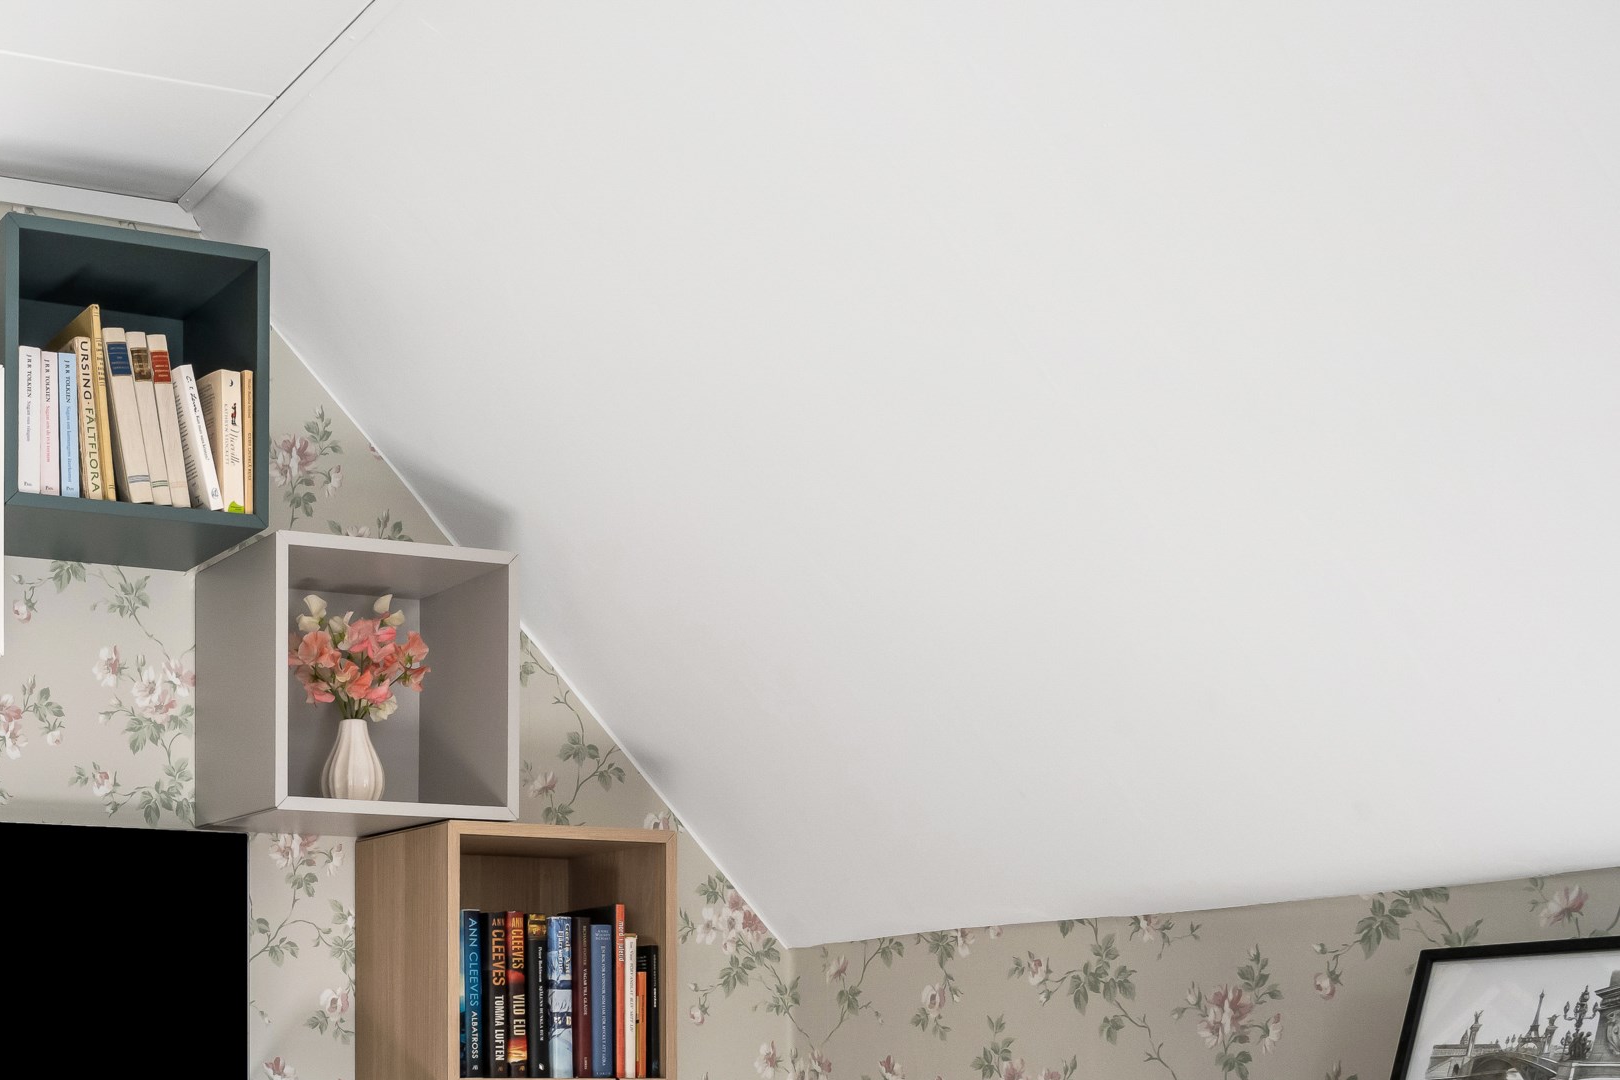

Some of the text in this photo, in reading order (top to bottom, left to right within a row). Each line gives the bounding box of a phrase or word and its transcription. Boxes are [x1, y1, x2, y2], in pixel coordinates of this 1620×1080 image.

[85, 408, 101, 493] FÄLTFLORA
[491, 917, 505, 927] ANN
[511, 917, 523, 927] ANN
[468, 918, 479, 1059] ANN CLEEVES ALBATROSS
[491, 928, 505, 1061] CLEEVES TOMMA LUFTEN
[511, 927, 526, 1037] CLEEVES VILD ELD
